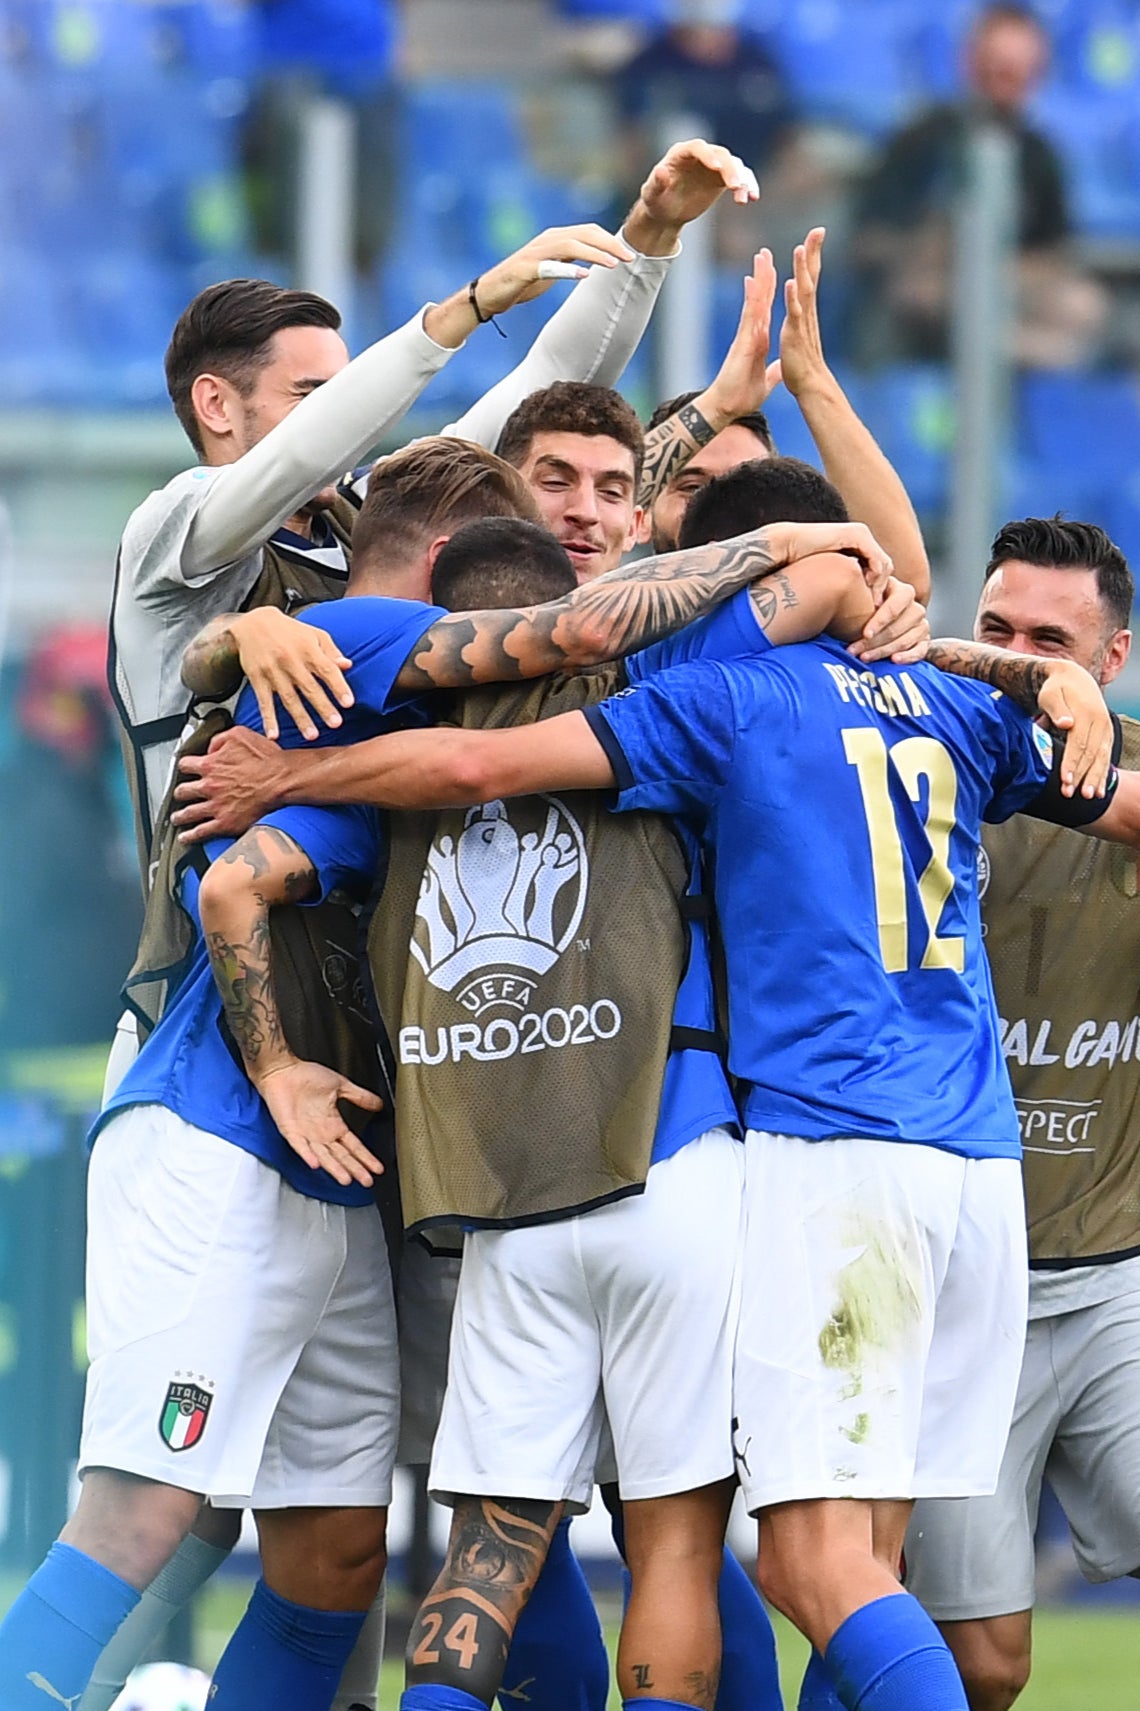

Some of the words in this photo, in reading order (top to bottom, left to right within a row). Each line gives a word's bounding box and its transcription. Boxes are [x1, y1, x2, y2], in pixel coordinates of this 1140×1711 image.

[841, 727, 965, 974] 12
[461, 980, 531, 1011] UEFA
[399, 999, 622, 1066] EURO2020
[170, 1385, 210, 1408] ITALIA
[412, 1612, 479, 1669] 24
